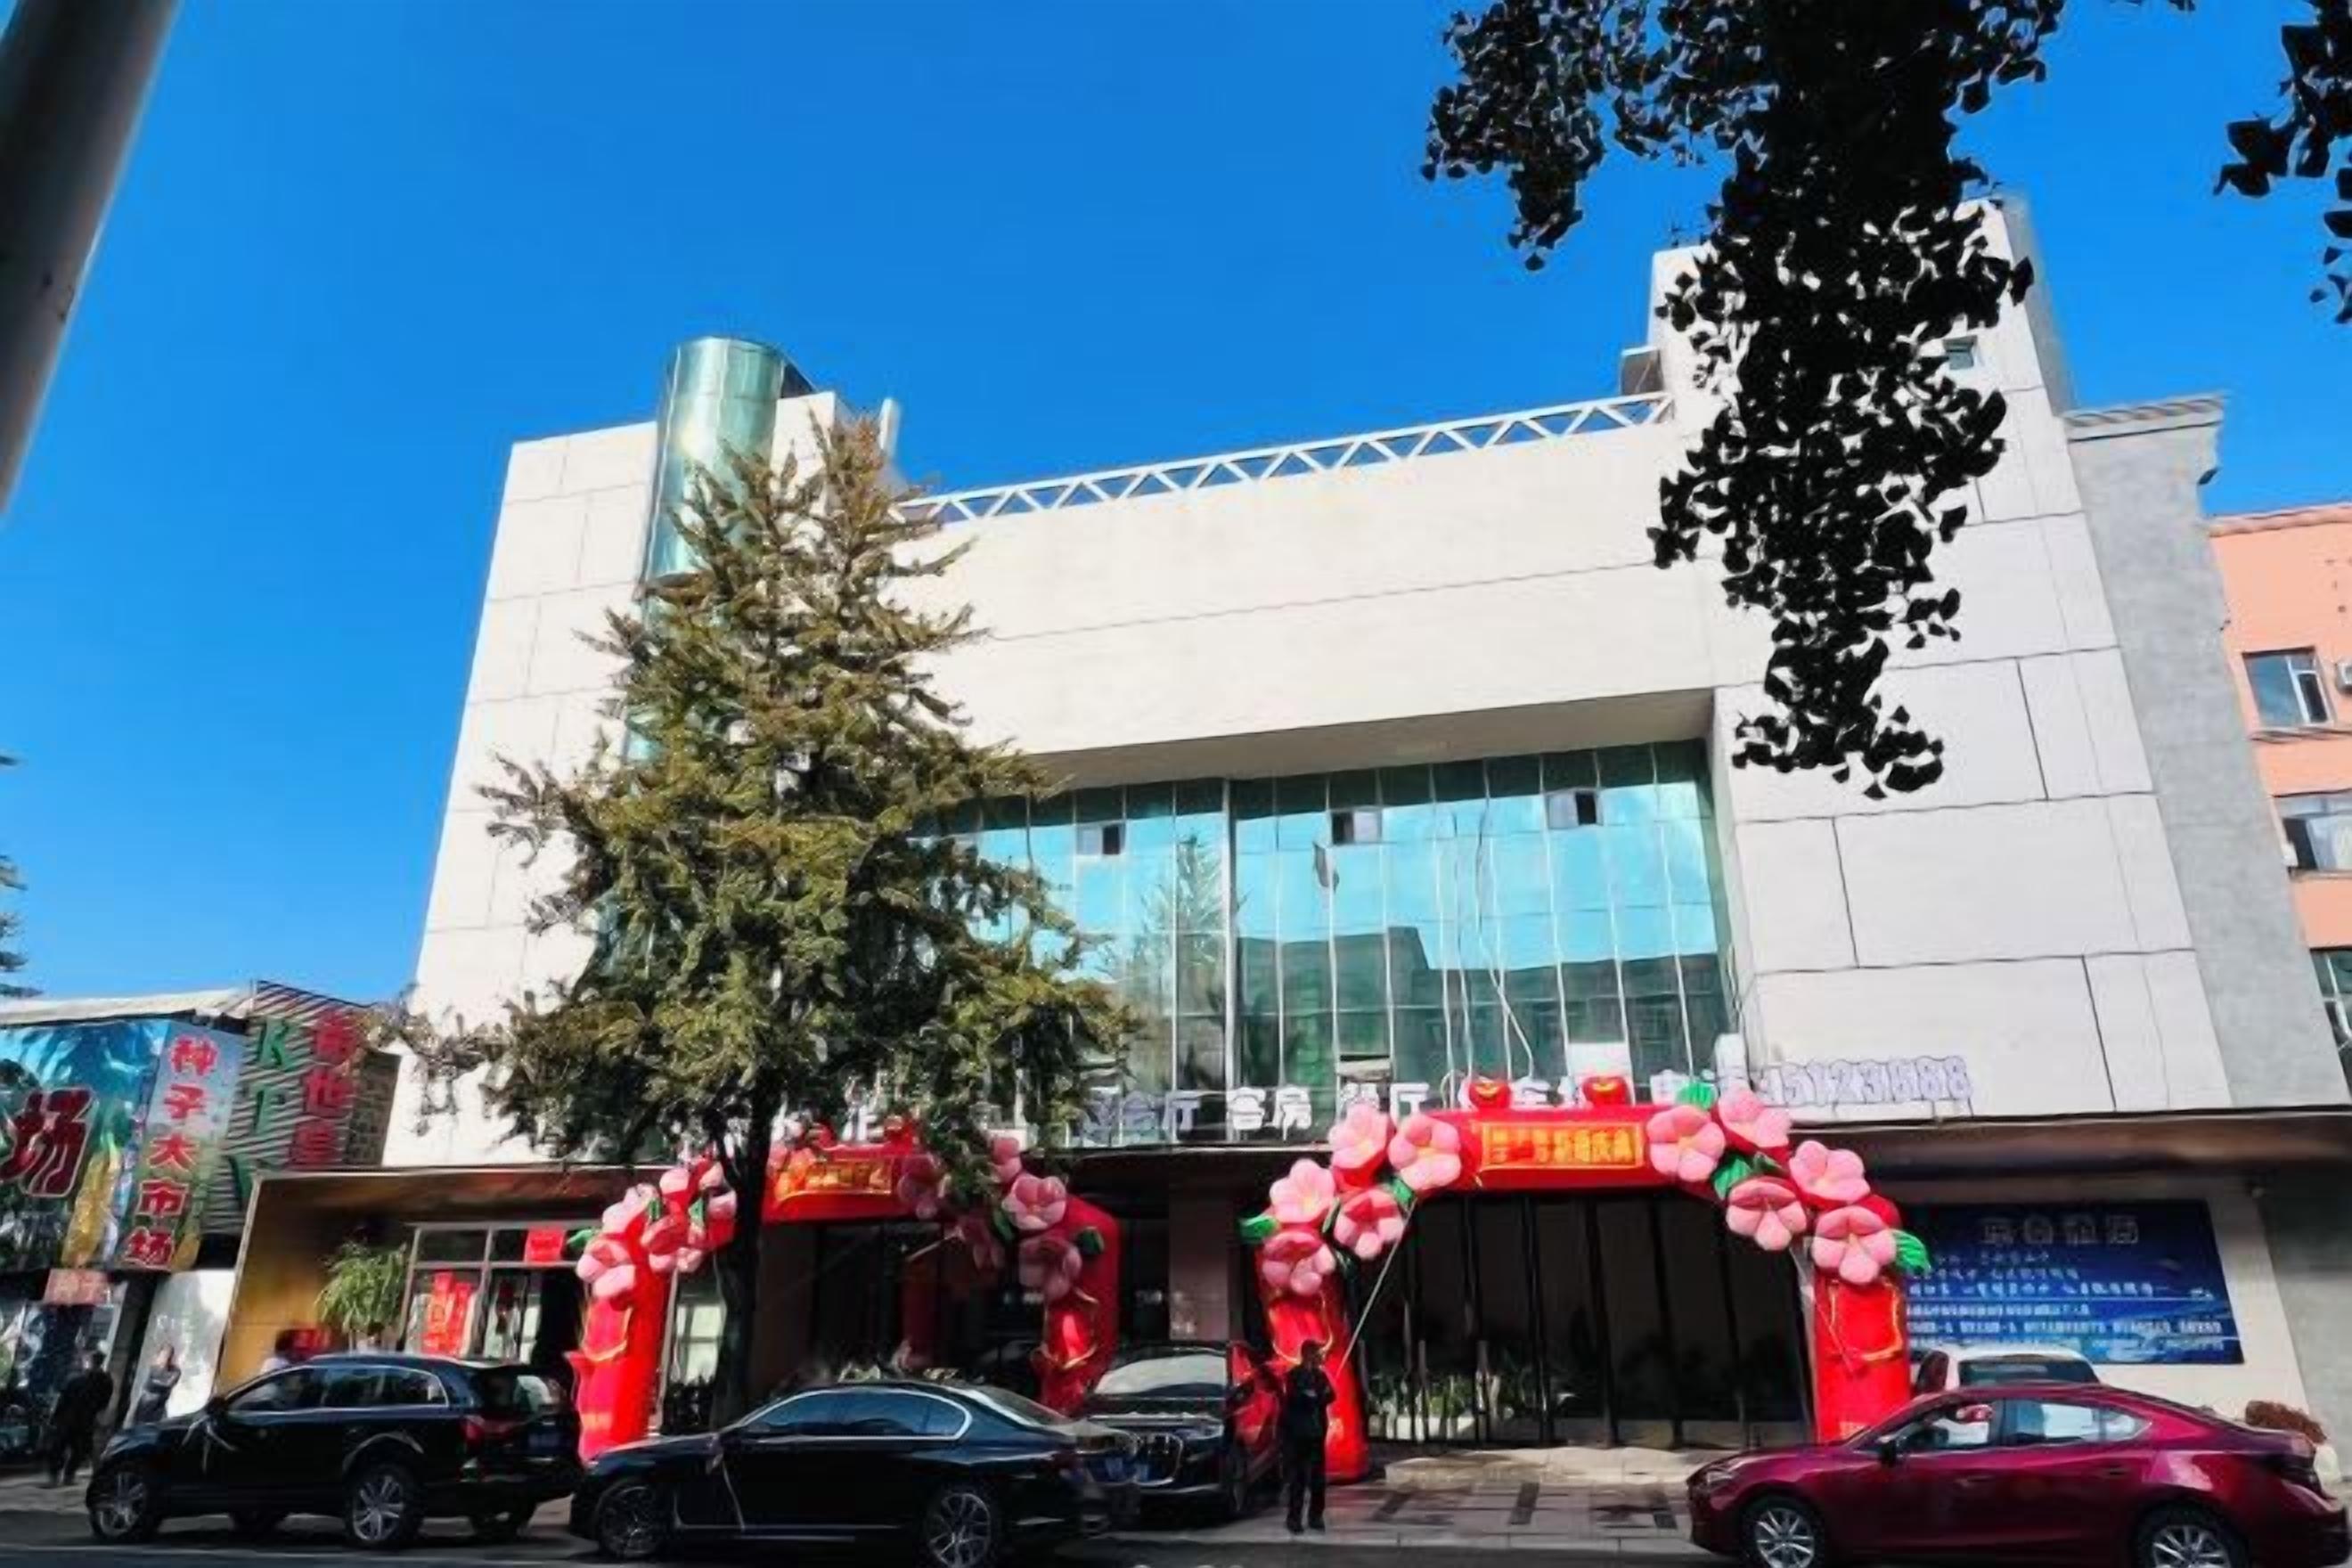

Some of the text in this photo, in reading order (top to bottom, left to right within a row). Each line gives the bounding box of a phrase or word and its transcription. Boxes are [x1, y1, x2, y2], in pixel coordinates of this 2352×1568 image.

[122, 1033, 220, 1270] 种子大市场
[1227, 1086, 1312, 1141] 客房
